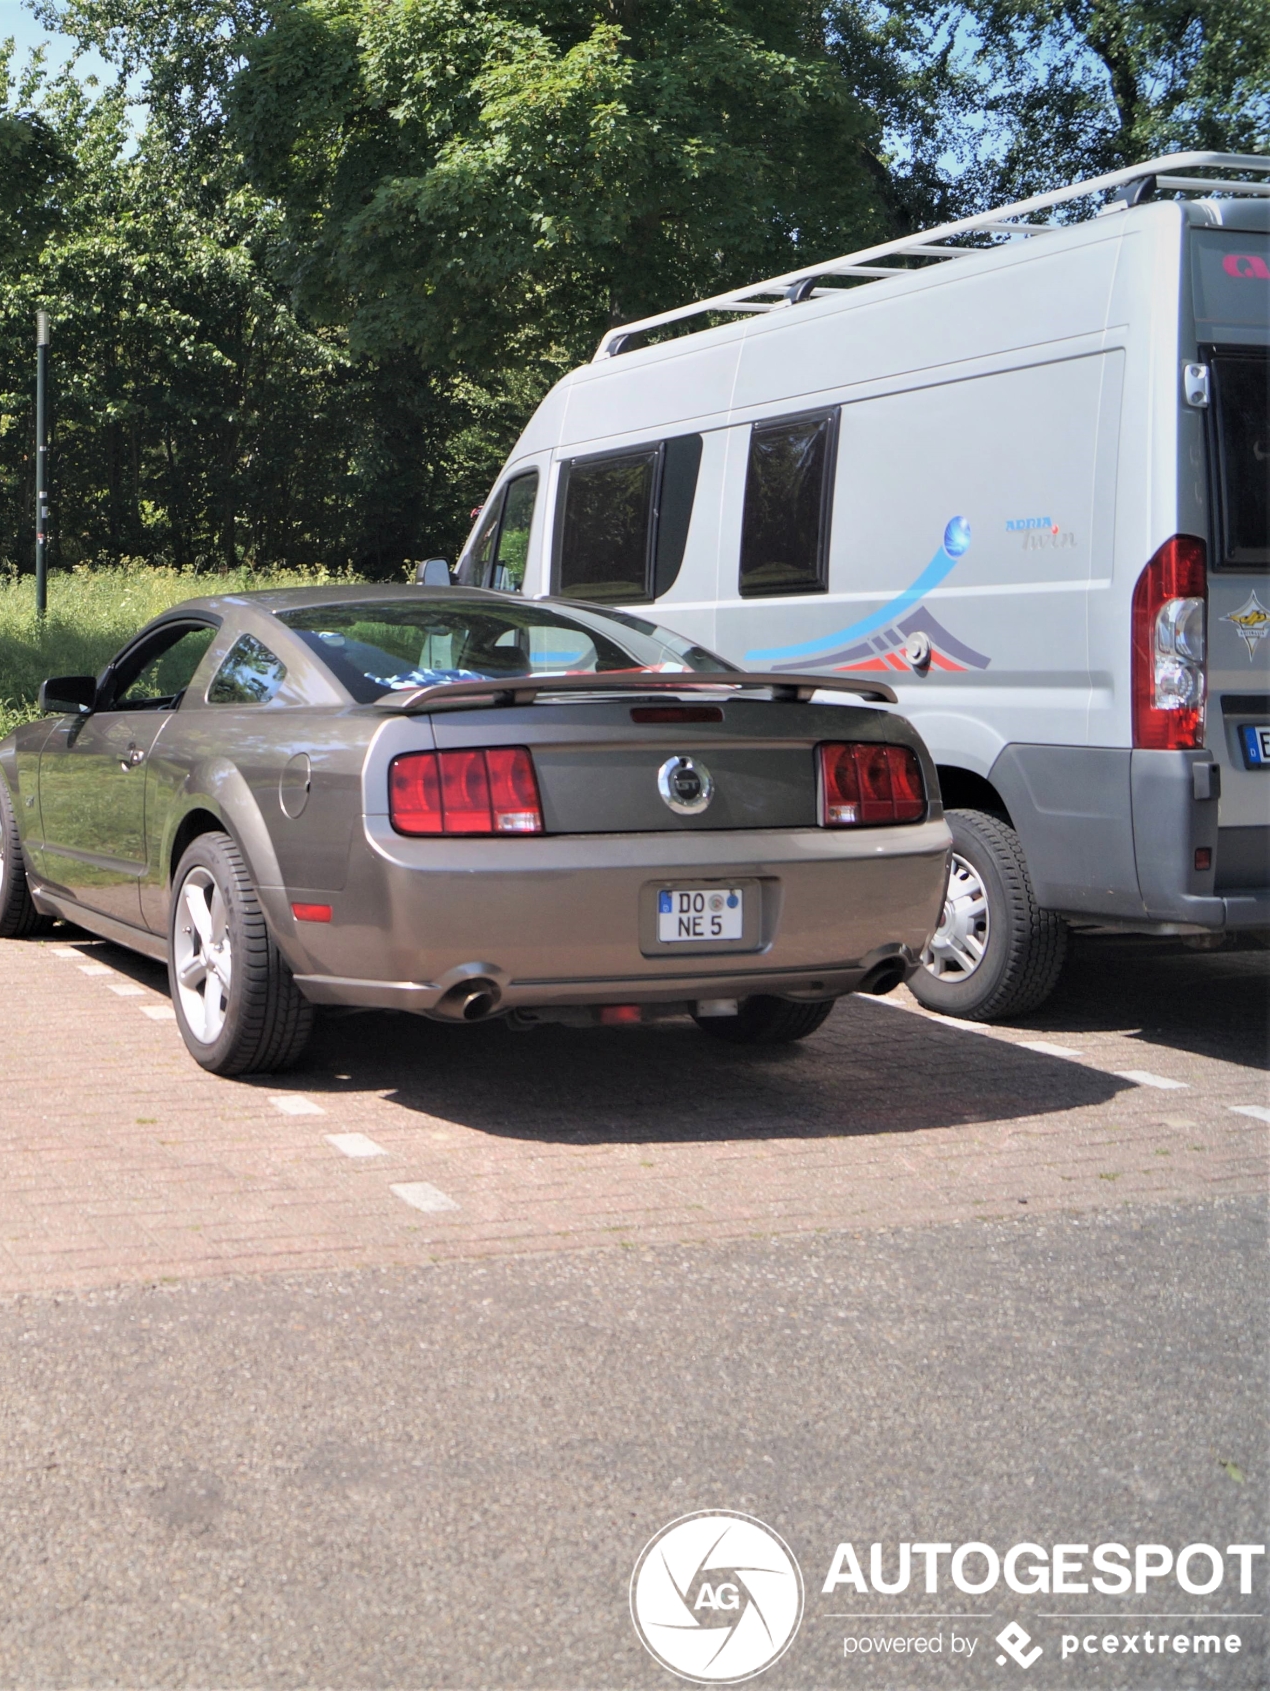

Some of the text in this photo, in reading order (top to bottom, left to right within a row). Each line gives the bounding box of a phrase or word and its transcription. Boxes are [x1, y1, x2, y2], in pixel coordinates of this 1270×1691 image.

[1006, 517, 1052, 532] ADRIA
[679, 893, 705, 913] DO
[678, 915, 722, 936] NE 5
